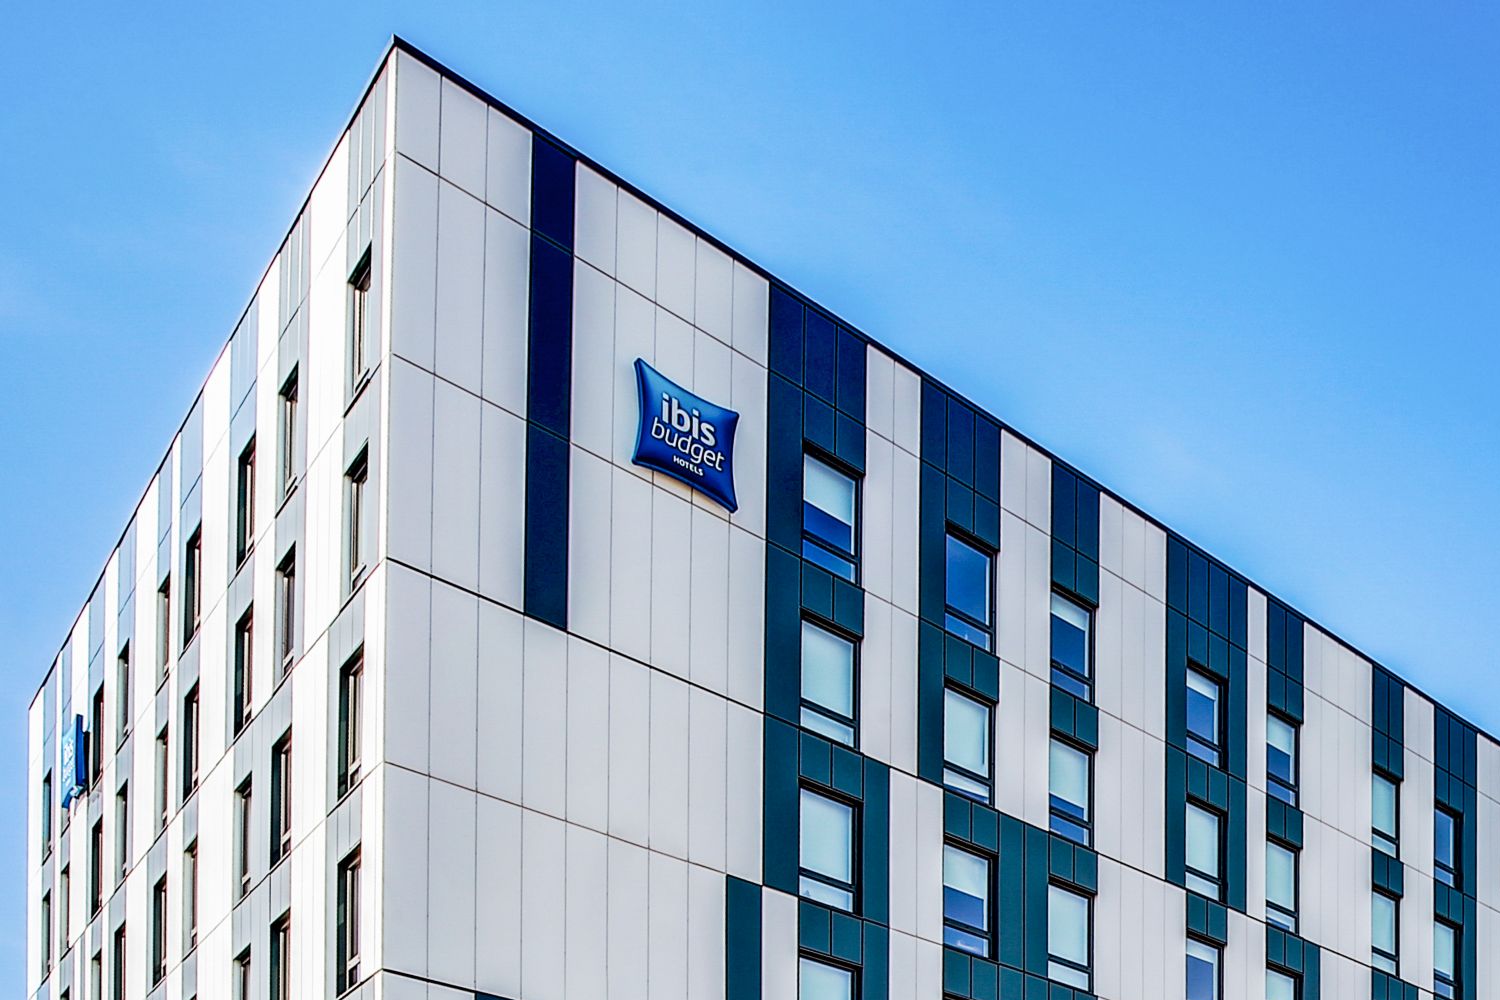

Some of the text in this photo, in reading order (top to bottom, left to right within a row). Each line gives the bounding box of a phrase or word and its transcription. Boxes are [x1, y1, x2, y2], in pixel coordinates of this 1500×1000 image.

[650, 416, 725, 471] budget
[662, 392, 716, 447] ibis
[673, 455, 704, 476] HOTELS
